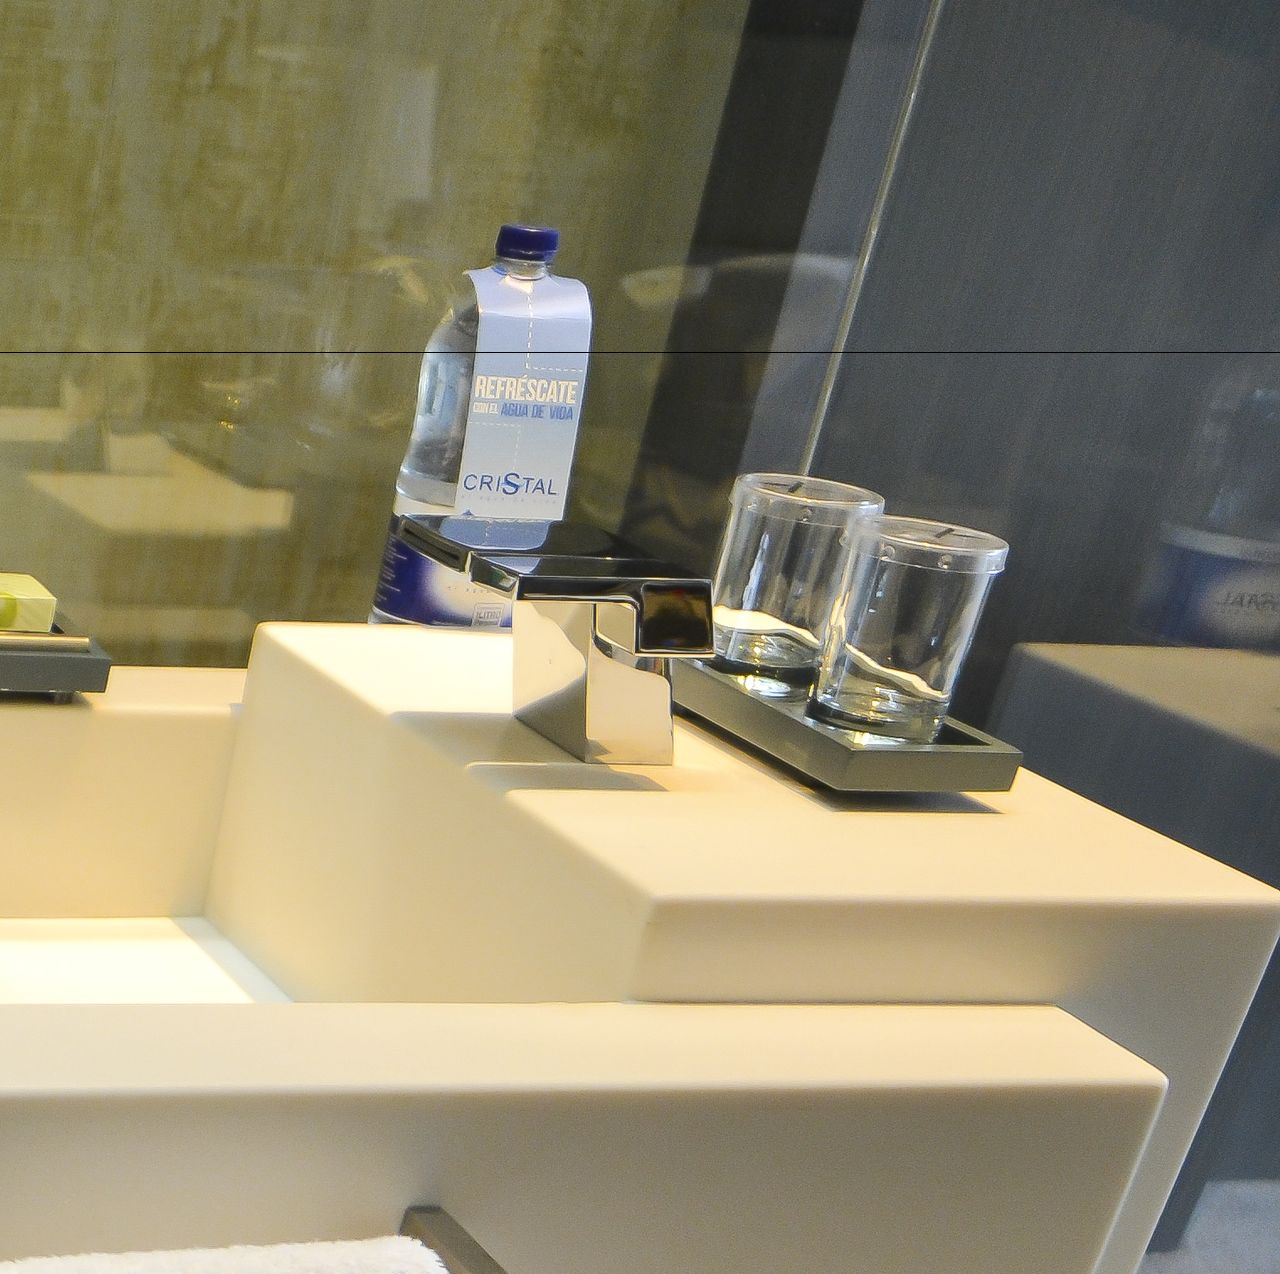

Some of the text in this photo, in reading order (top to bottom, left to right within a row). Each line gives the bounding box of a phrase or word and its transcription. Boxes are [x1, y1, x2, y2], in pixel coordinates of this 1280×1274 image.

[474, 374, 578, 404] REFRÉSCATE
[501, 402, 528, 417] AGUA
[531, 404, 544, 418] DE
[549, 405, 573, 420] VIDA
[463, 472, 557, 496] CRISTAL
